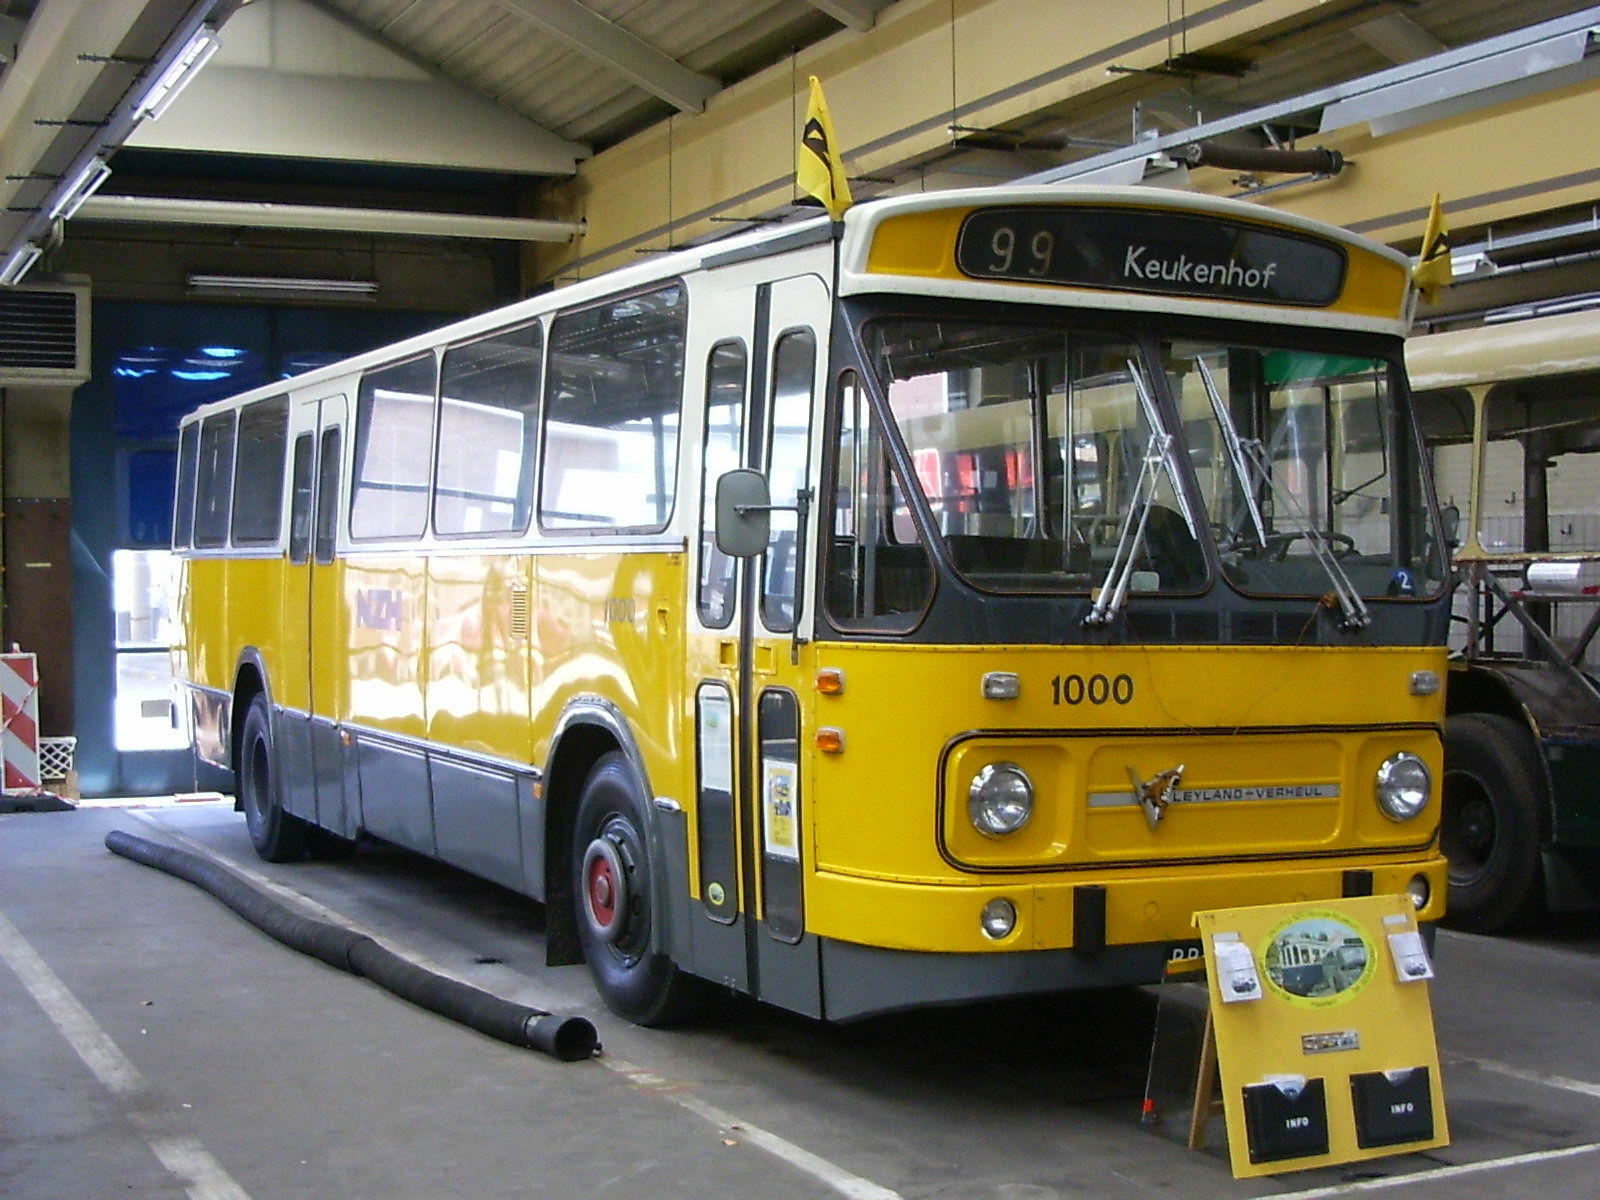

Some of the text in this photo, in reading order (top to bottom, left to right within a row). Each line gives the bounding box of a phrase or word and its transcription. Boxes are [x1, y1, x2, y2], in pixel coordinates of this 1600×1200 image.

[1123, 245, 1277, 289] Keukenhof
[1398, 571, 1411, 588] 2
[1051, 673, 1134, 705] 1000
[1390, 1102, 1414, 1114] INFO
[1285, 1116, 1309, 1129] INFO
